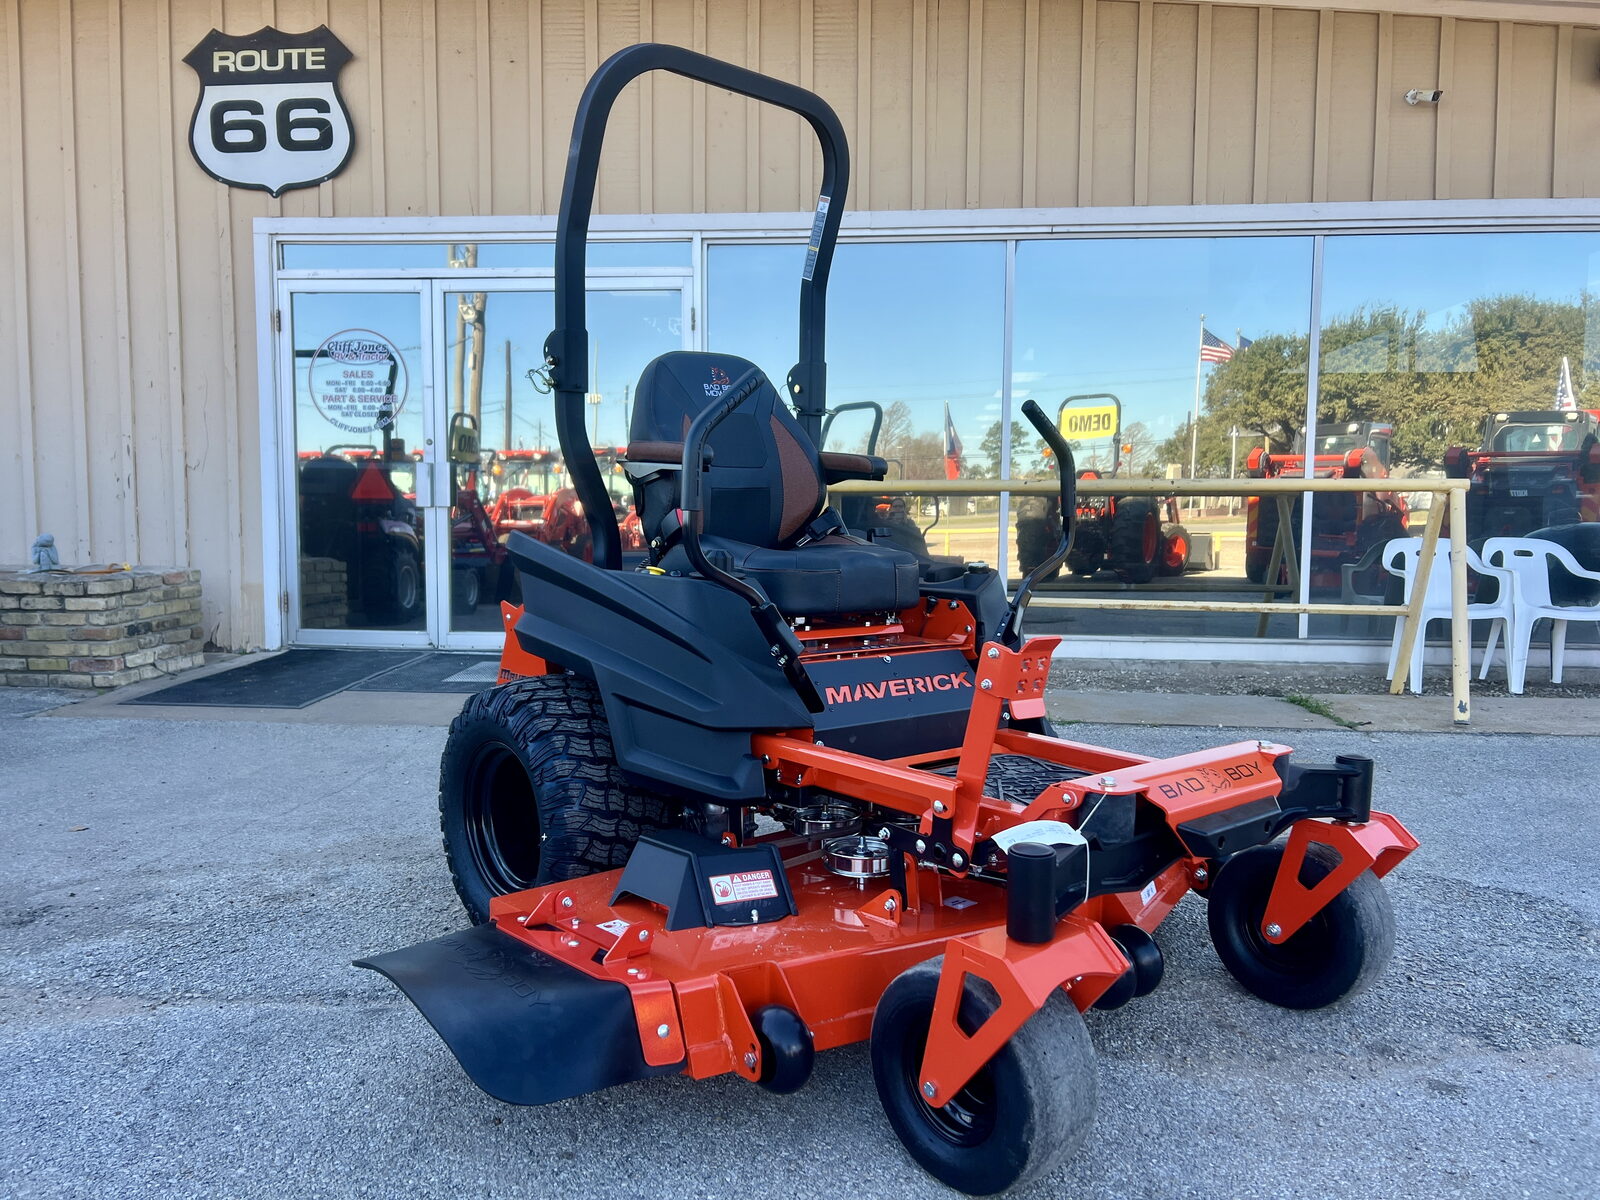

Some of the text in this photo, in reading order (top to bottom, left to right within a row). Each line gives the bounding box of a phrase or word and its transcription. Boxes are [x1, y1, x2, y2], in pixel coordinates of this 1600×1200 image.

[213, 48, 326, 73] ROUTE
[210, 97, 334, 154] 66
[327, 341, 388, 353] Cliff Jones
[343, 370, 374, 379] SALES
[323, 395, 398, 404] PART & SERVICE
[825, 672, 973, 705] MAVERICK
[1158, 761, 1263, 800] BAD BOY
[741, 871, 771, 882] DANGER
[502, 975, 552, 1008] BOY
